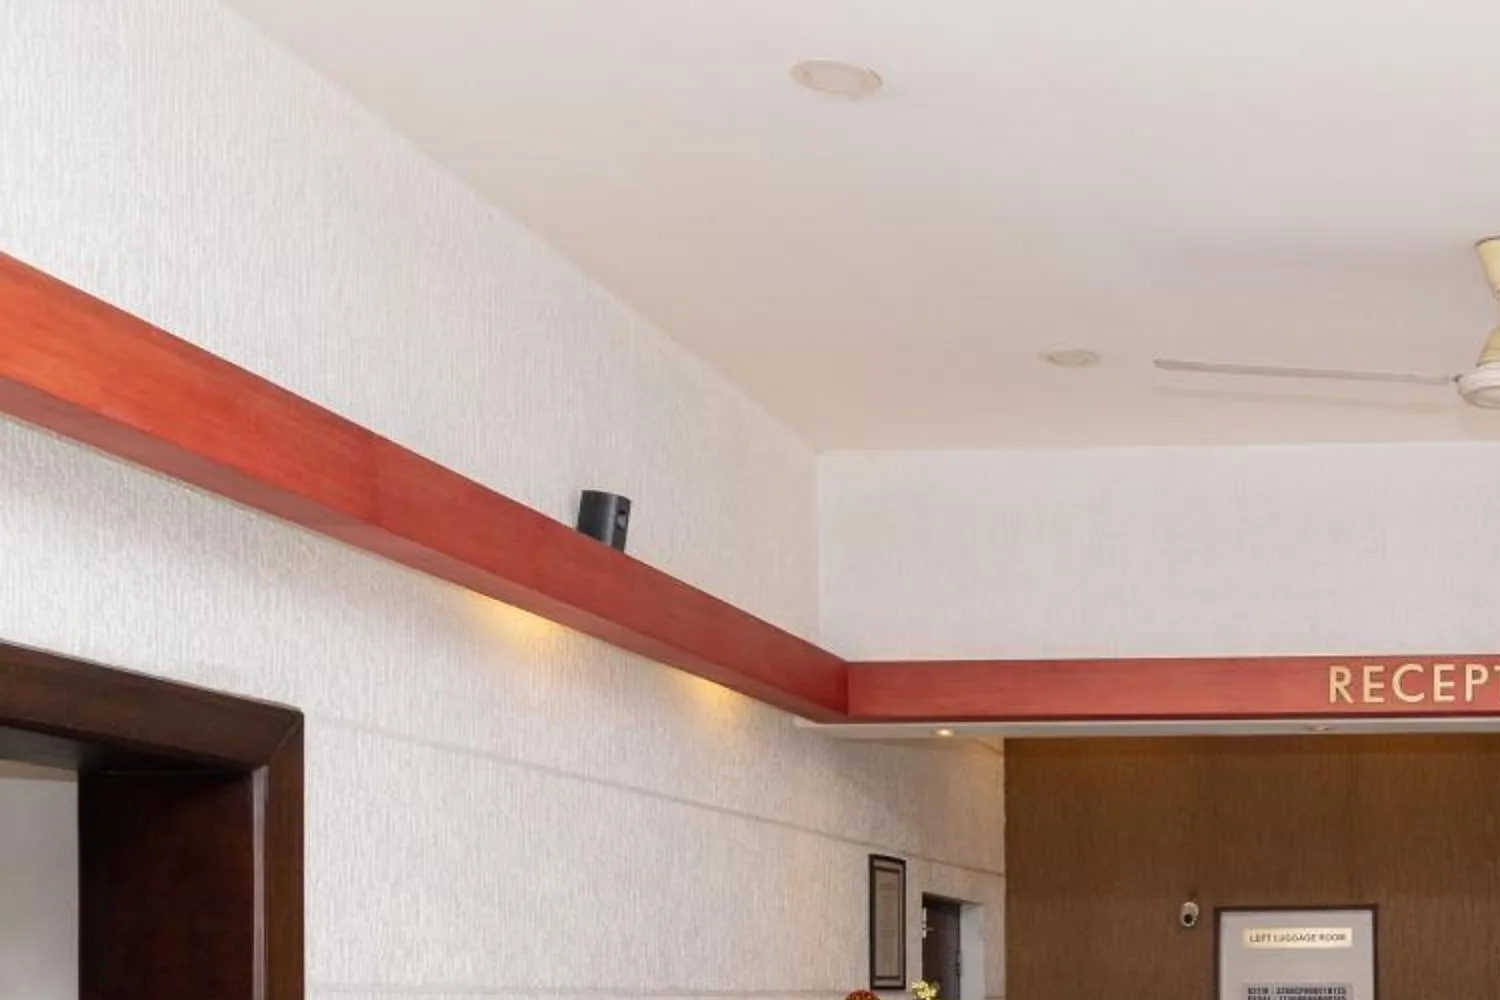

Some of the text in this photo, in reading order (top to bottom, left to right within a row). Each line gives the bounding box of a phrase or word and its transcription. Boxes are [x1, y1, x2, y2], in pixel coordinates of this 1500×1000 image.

[1249, 933, 1346, 943] LEFT LUGGAGE ROOM
